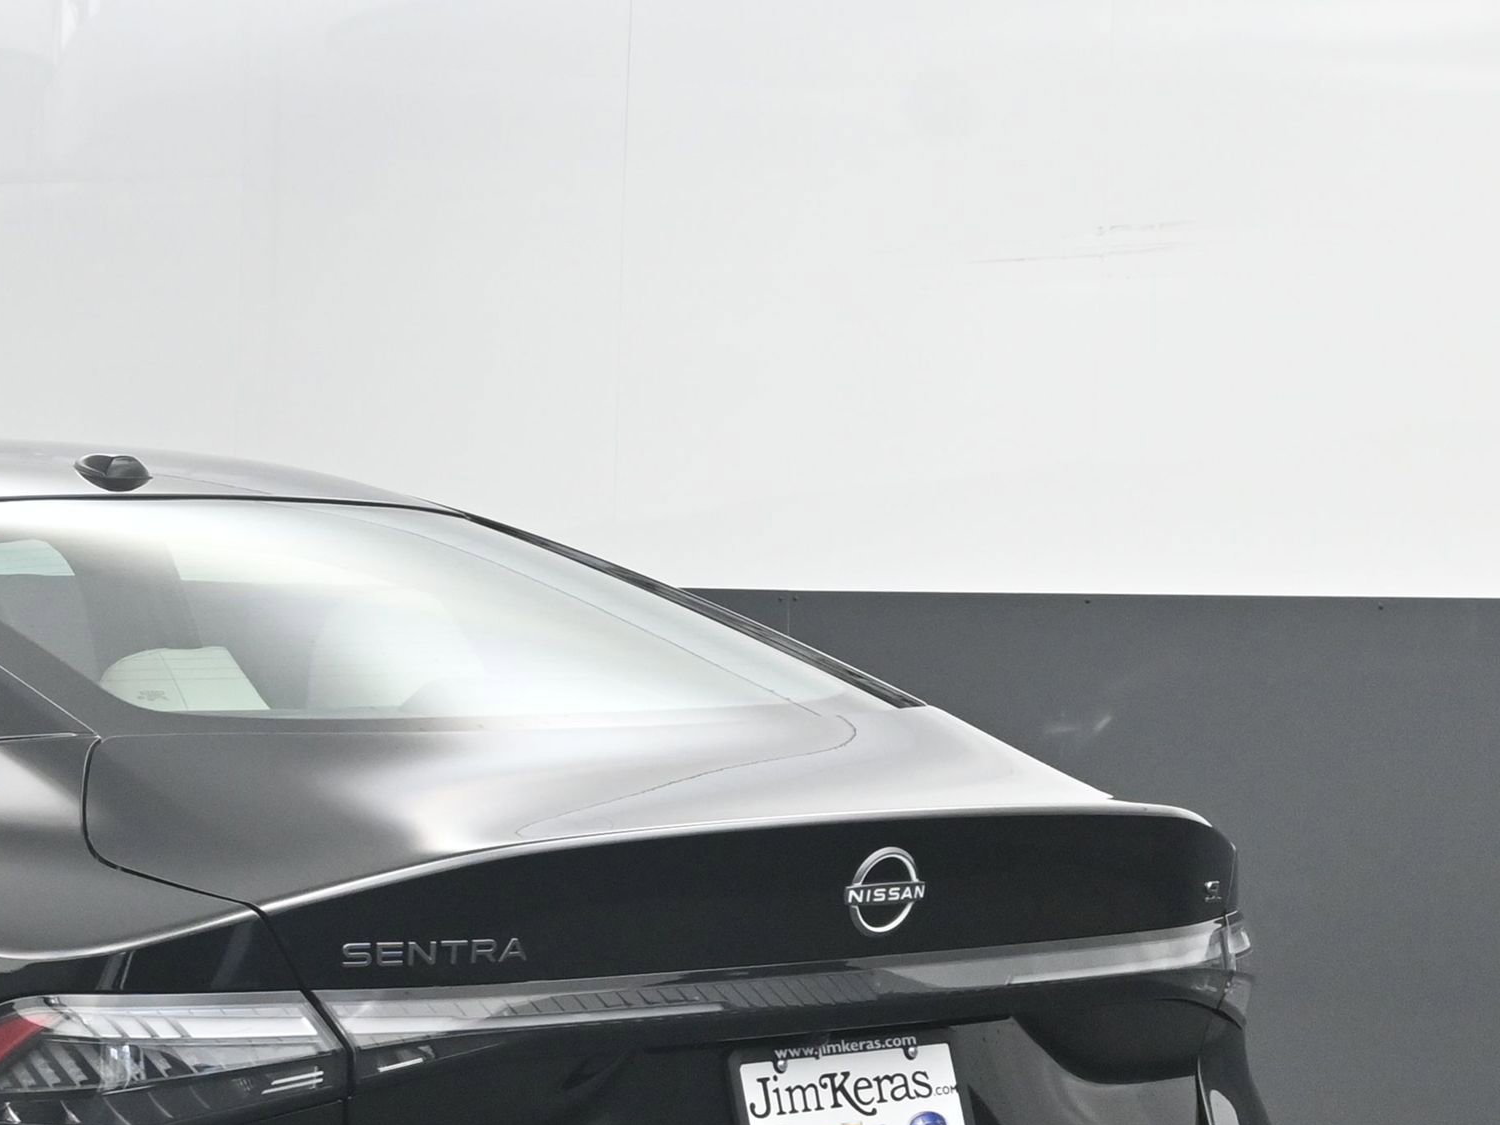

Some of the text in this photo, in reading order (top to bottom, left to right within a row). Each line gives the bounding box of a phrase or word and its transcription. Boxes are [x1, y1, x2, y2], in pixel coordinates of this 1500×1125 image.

[848, 885, 926, 904] NISSAN
[342, 937, 527, 968] SENTRA
[774, 1034, 917, 1059] www.jimkeras.com
